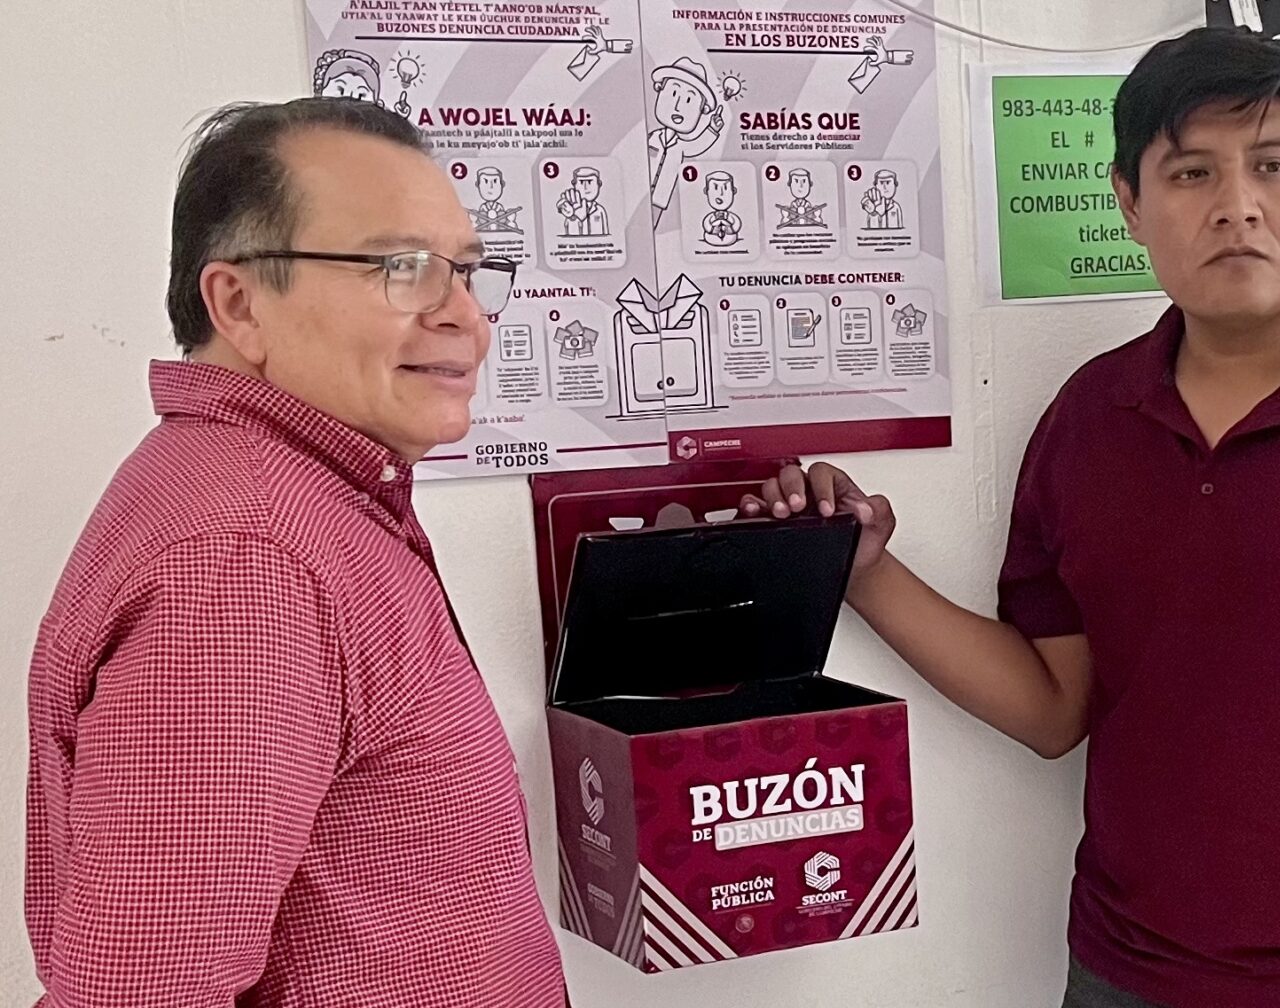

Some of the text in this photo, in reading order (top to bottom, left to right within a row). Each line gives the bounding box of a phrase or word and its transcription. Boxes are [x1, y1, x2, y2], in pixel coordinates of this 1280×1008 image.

[386, 12, 393, 20] U
[524, 16, 580, 24] DENUNCIAS
[672, 9, 905, 24] INFORMACIÓN E INSTRUCCIONES COMUNES
[377, 22, 580, 36] BUZONES DENUNCIA CIUDADANA
[694, 22, 887, 34] PARA LA PRESENTACIÓN DE DENUNCIAS
[725, 33, 859, 48] EN LOS BUZONES
[418, 103, 591, 126] A WOJEL WÁAJ:
[1002, 98, 1116, 118] 983-443-48-
[740, 107, 860, 130] SABÍAS QUE
[741, 133, 770, 141] Tienes
[772, 133, 808, 141] derecho
[816, 133, 860, 141] denunciar
[1051, 130, 1095, 148] EL #
[1021, 163, 1089, 181] ENVIAR
[1010, 193, 1117, 214] COMBUSTIB
[1070, 254, 1151, 275] GRACIAS.
[719, 272, 904, 287] TU DENUNCIA DEBE CONTENER:
[524, 287, 577, 298] YAANTAL
[475, 441, 548, 455] GOBIERNO
[476, 453, 549, 468] DE TODOS
[689, 756, 866, 826] BUZÓN
[692, 808, 861, 848] DE DENUNCIAS
[711, 875, 774, 898] FUNCIÓN
[711, 889, 775, 910] PÚBLICA
[801, 889, 848, 906] SECONT
